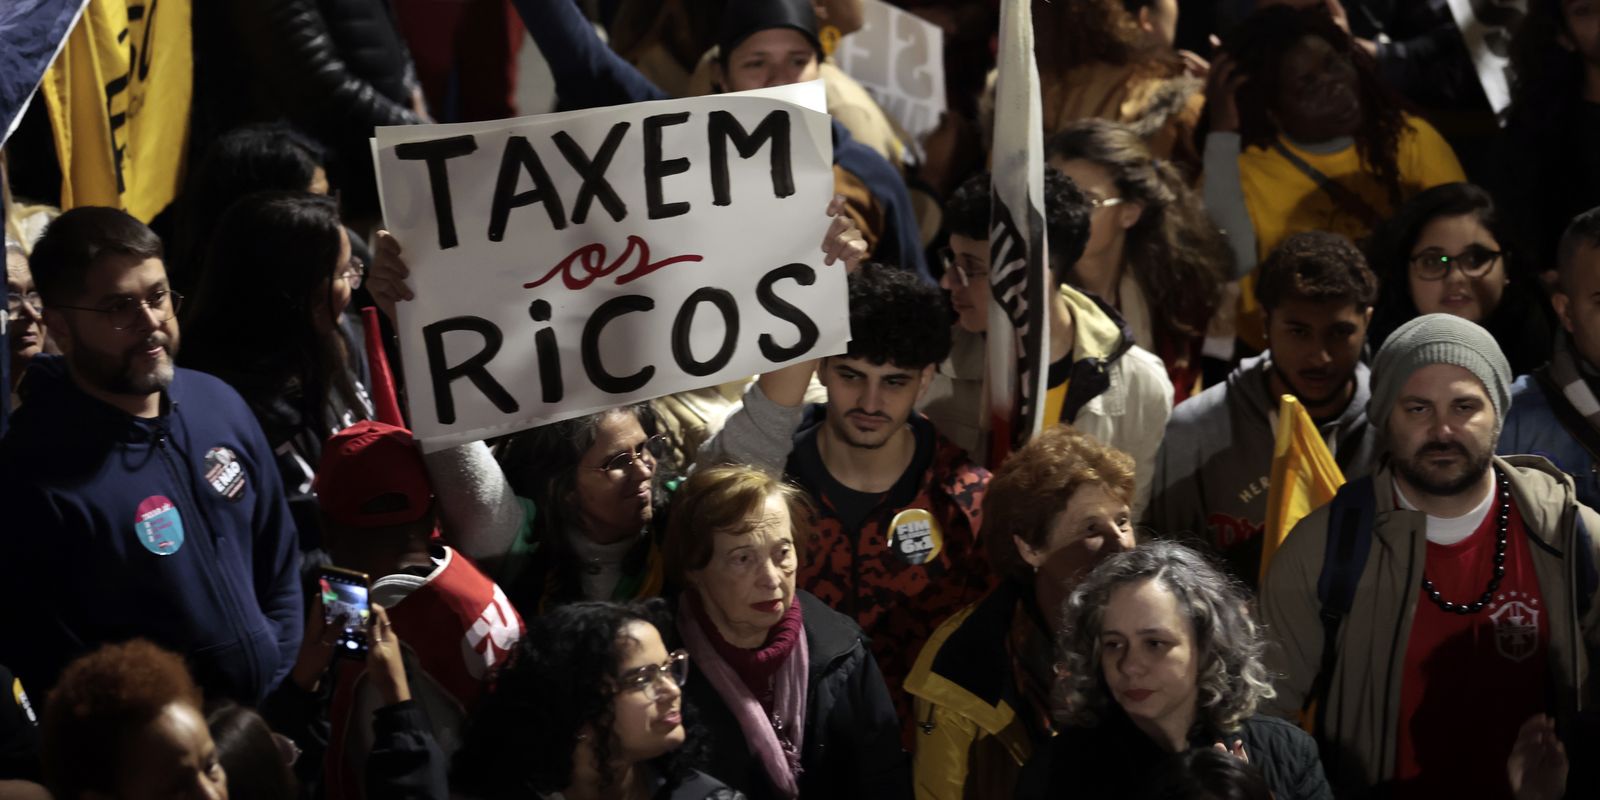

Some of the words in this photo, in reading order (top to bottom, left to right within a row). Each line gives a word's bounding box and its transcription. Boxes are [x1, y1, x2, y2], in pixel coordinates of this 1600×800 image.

[395, 110, 795, 250] TAXEM
[523, 235, 703, 290] os
[896, 520, 930, 535] FIM
